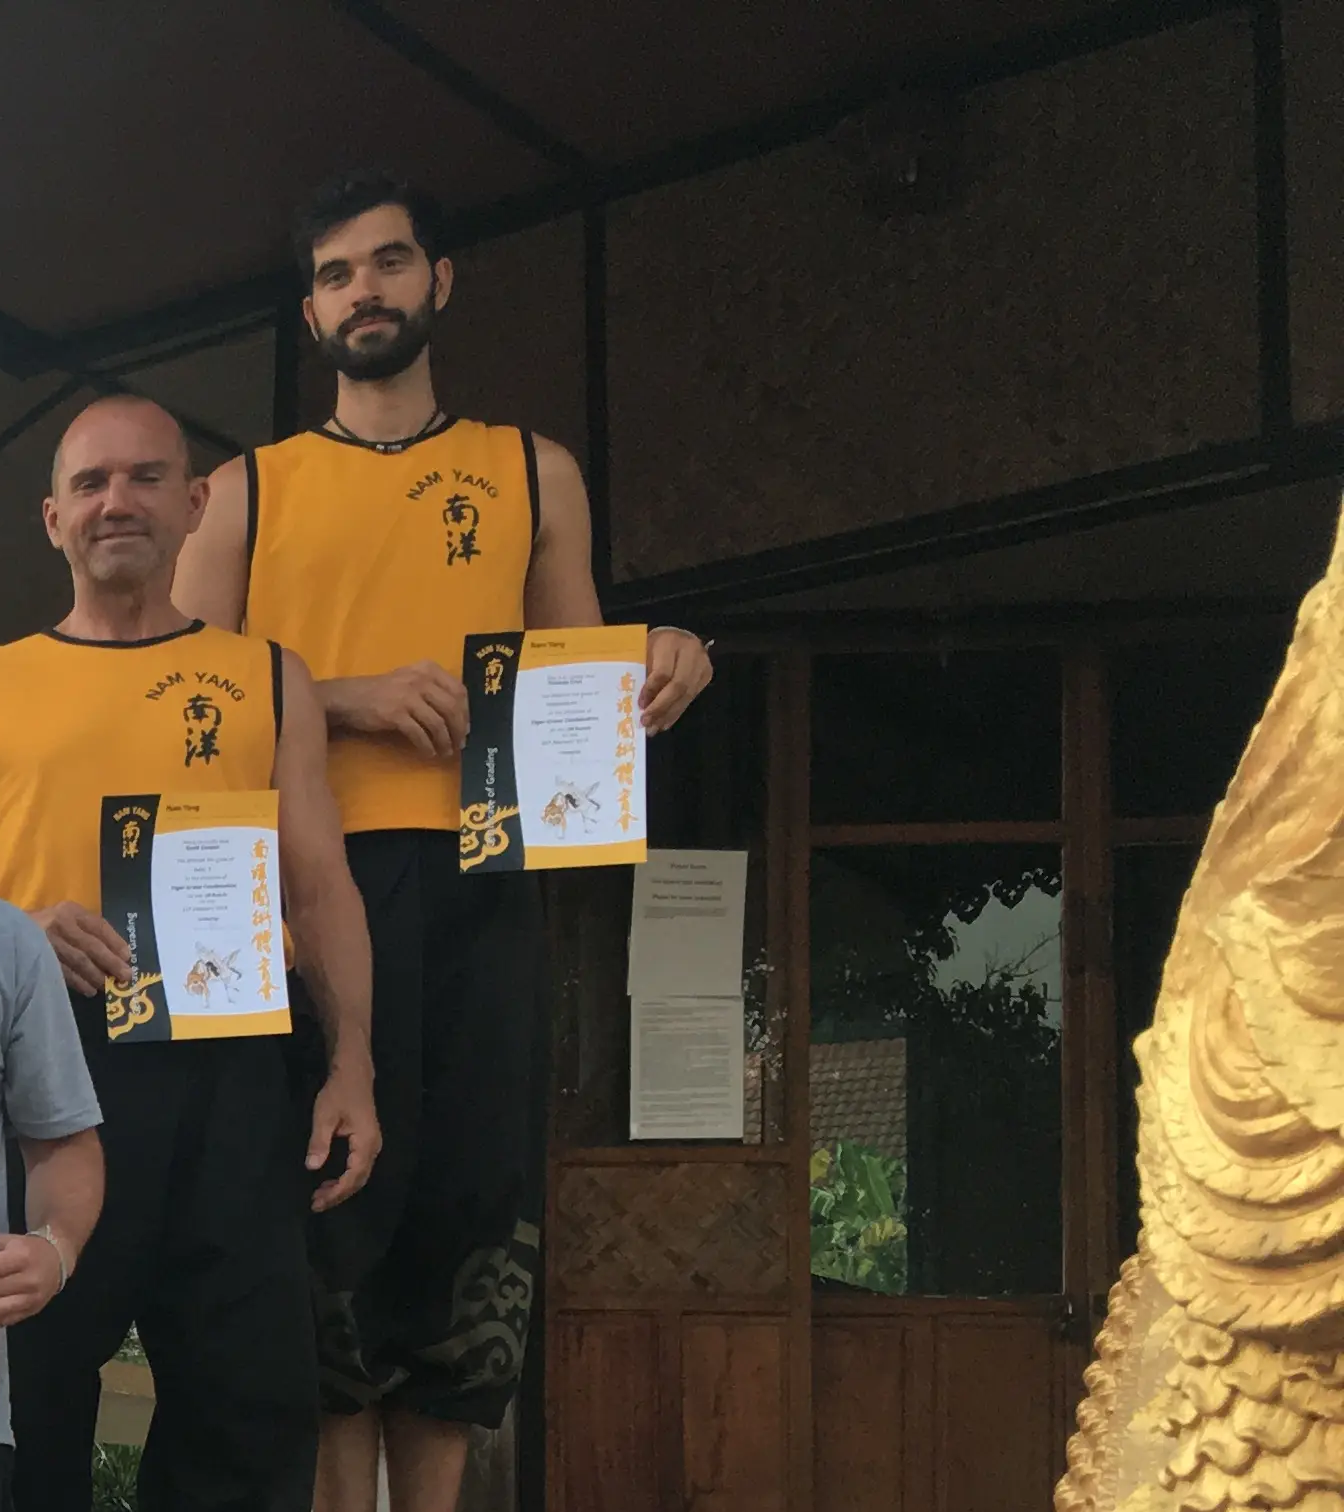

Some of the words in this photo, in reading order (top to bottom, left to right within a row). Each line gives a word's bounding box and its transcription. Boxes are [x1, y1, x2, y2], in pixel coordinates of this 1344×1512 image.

[406, 470, 444, 501] NAM
[452, 468, 500, 499] YANG
[442, 493, 482, 566] 南洋
[145, 671, 185, 701] NAM
[194, 671, 246, 702] YANG
[484, 658, 503, 695] 南洋
[183, 692, 222, 768] 南洋
[122, 821, 140, 858] 南洋
